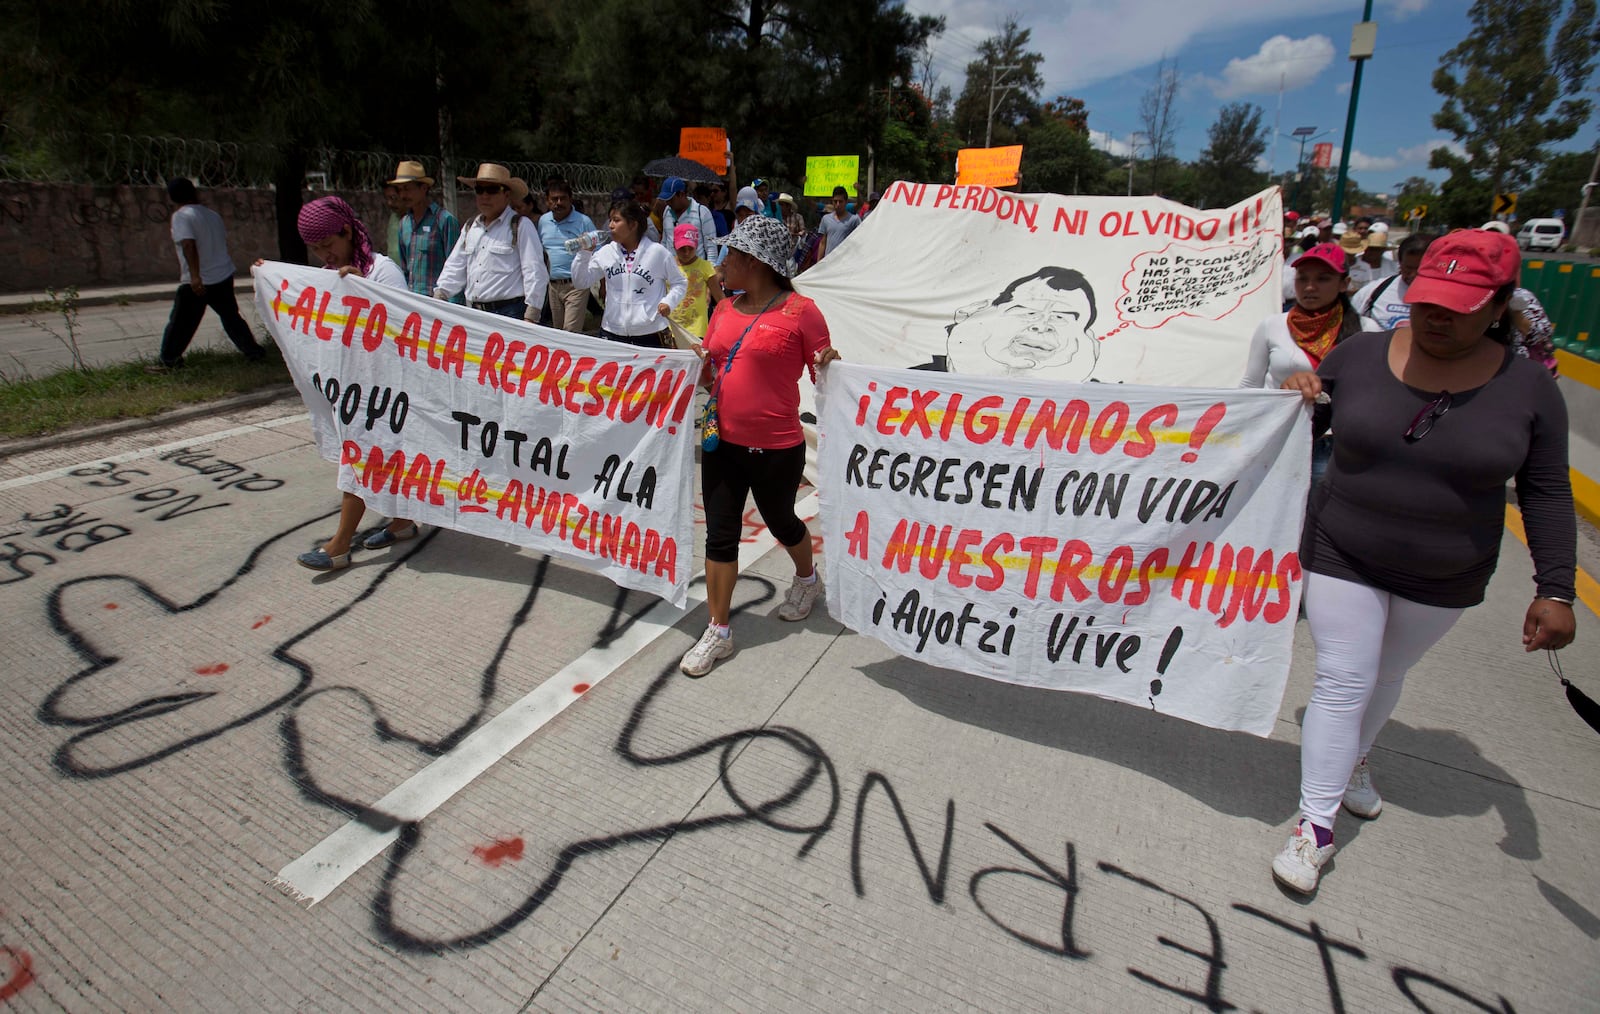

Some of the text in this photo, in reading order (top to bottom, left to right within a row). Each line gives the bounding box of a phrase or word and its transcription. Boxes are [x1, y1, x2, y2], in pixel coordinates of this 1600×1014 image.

[1053, 207, 1088, 237] NI
[1149, 257, 1169, 266] NO
[1201, 264, 1232, 276] QUE
[452, 410, 571, 481] TOTAL
[845, 444, 1239, 525] REGRESEN CON VIDA
[457, 467, 489, 504] de
[496, 478, 678, 585] AYOTZINAPA
[844, 510, 870, 562] A
[881, 518, 1170, 607] NUESTROS
[1171, 540, 1304, 630] HIJOS
